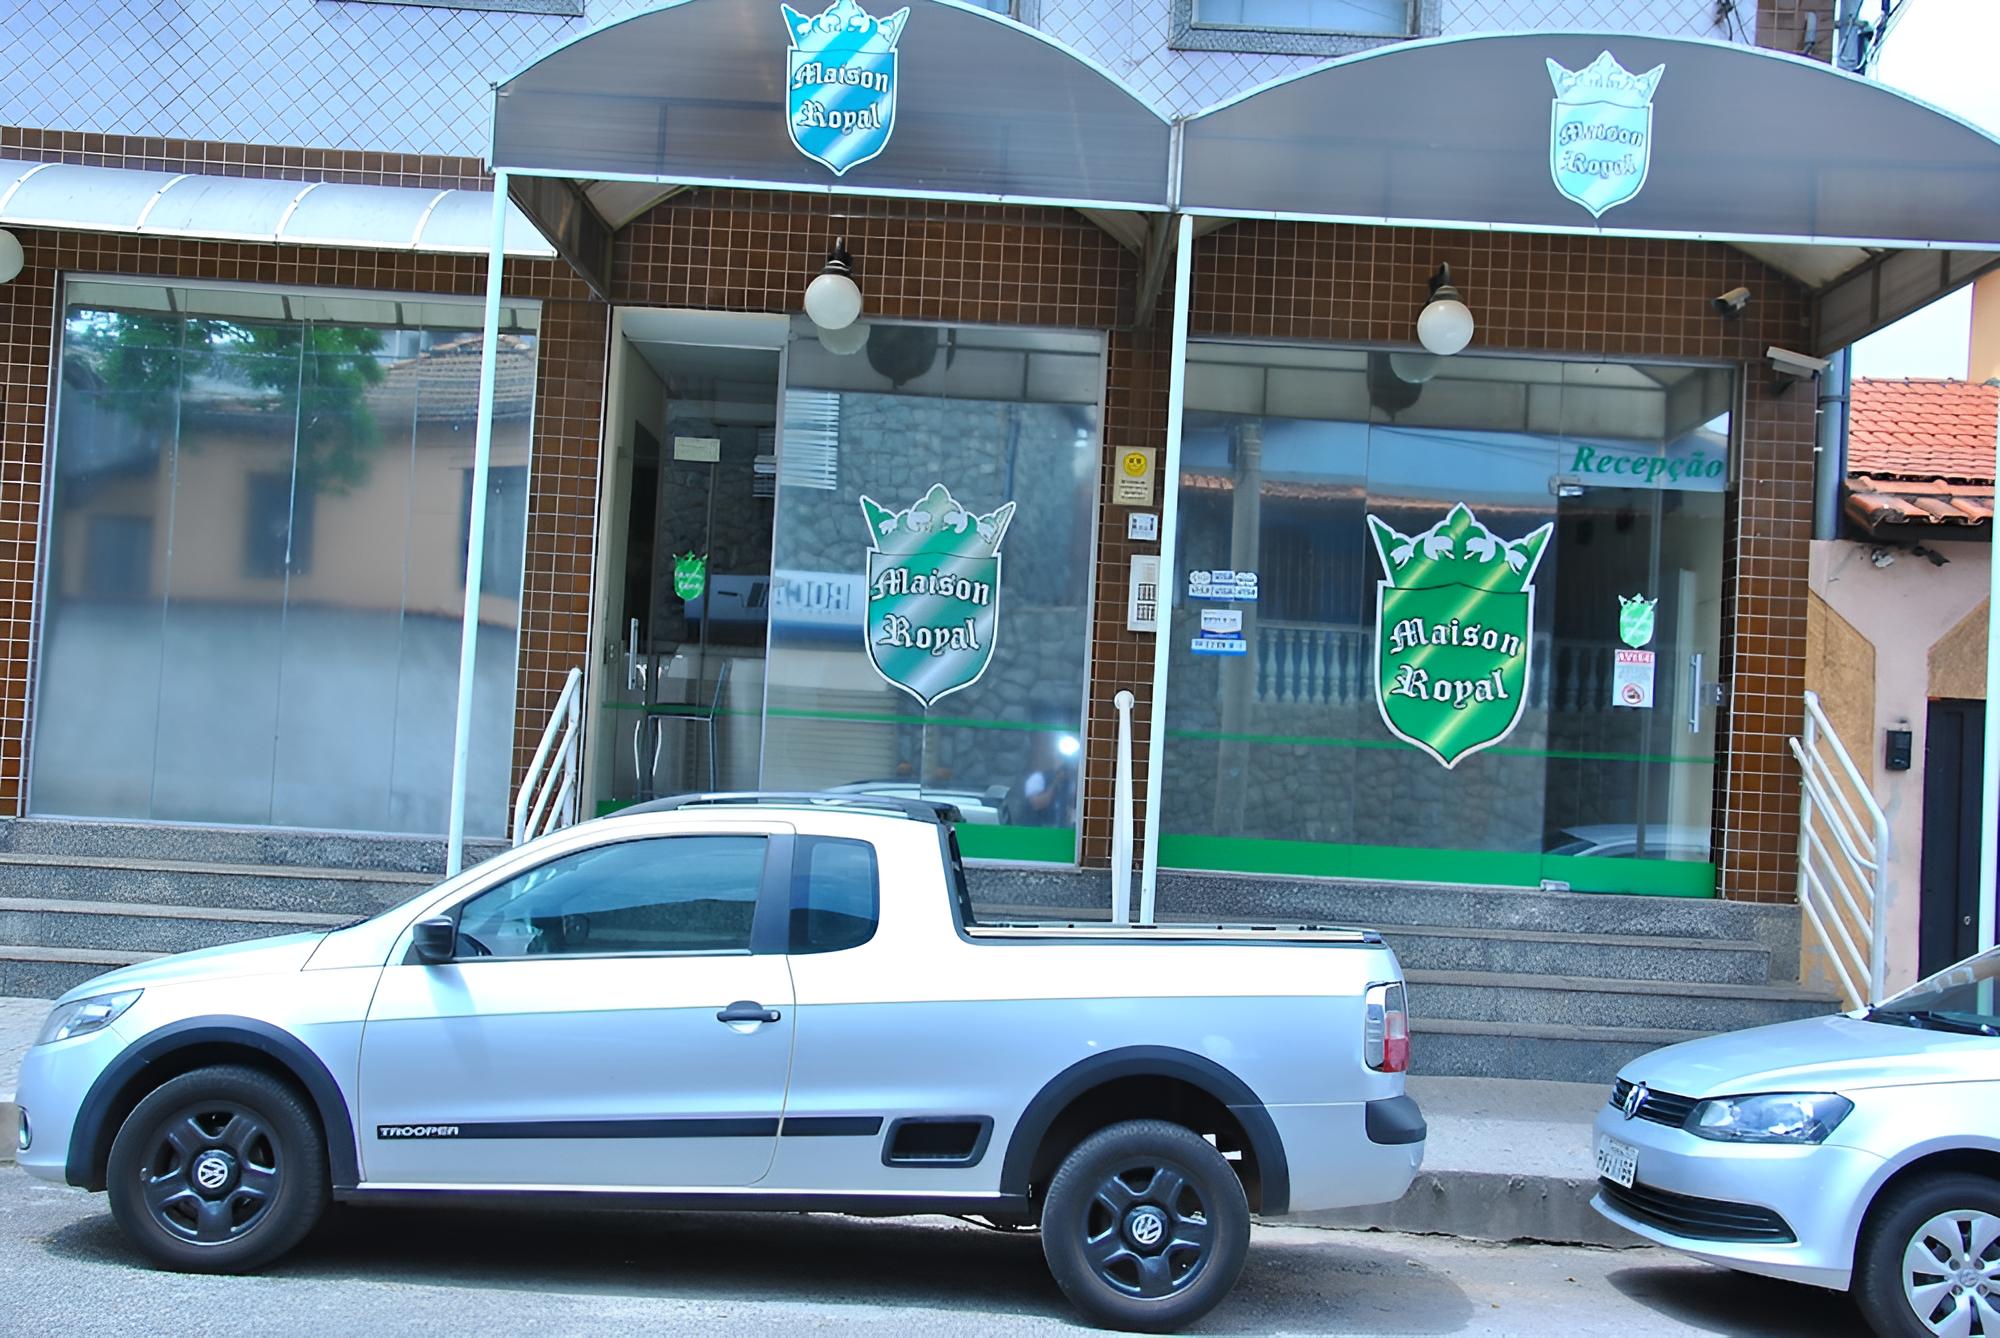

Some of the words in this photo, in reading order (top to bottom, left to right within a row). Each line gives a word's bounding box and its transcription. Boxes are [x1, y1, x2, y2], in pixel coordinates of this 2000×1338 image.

[792, 61, 889, 93] Maison
[796, 99, 881, 135] Royal
[1559, 121, 1644, 147] Maison
[1571, 446, 1724, 484] Recepção
[870, 567, 991, 606] Maison
[877, 612, 981, 657] Royal
[1389, 617, 1523, 657] Maison
[1391, 664, 1510, 708] Royal
[380, 1125, 459, 1137] TROOPER
